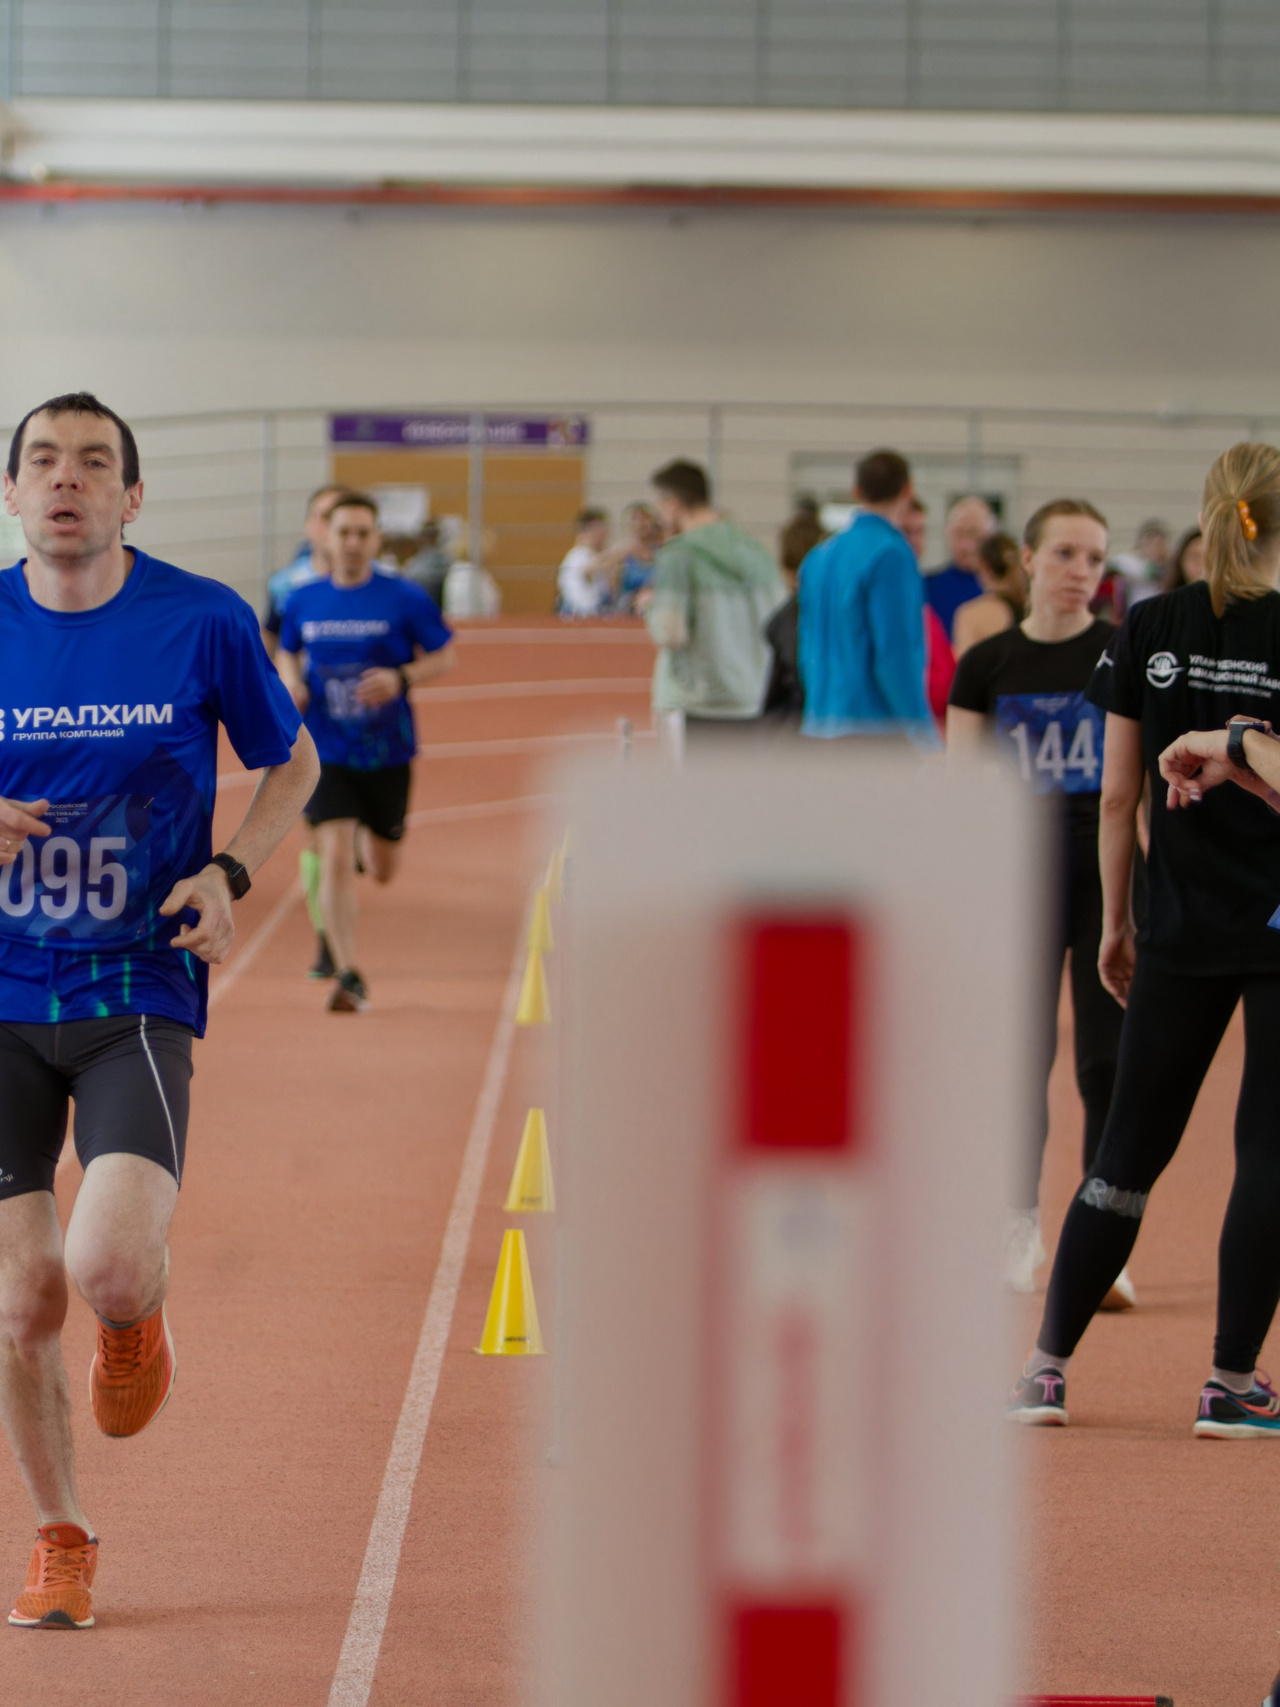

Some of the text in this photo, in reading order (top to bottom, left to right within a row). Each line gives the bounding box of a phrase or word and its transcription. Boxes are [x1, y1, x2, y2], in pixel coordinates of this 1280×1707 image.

[12, 704, 173, 728] УРАЛХИМ
[12, 728, 125, 741] ГРУППА КОМПАНИЙ
[1010, 718, 1099, 781] 144
